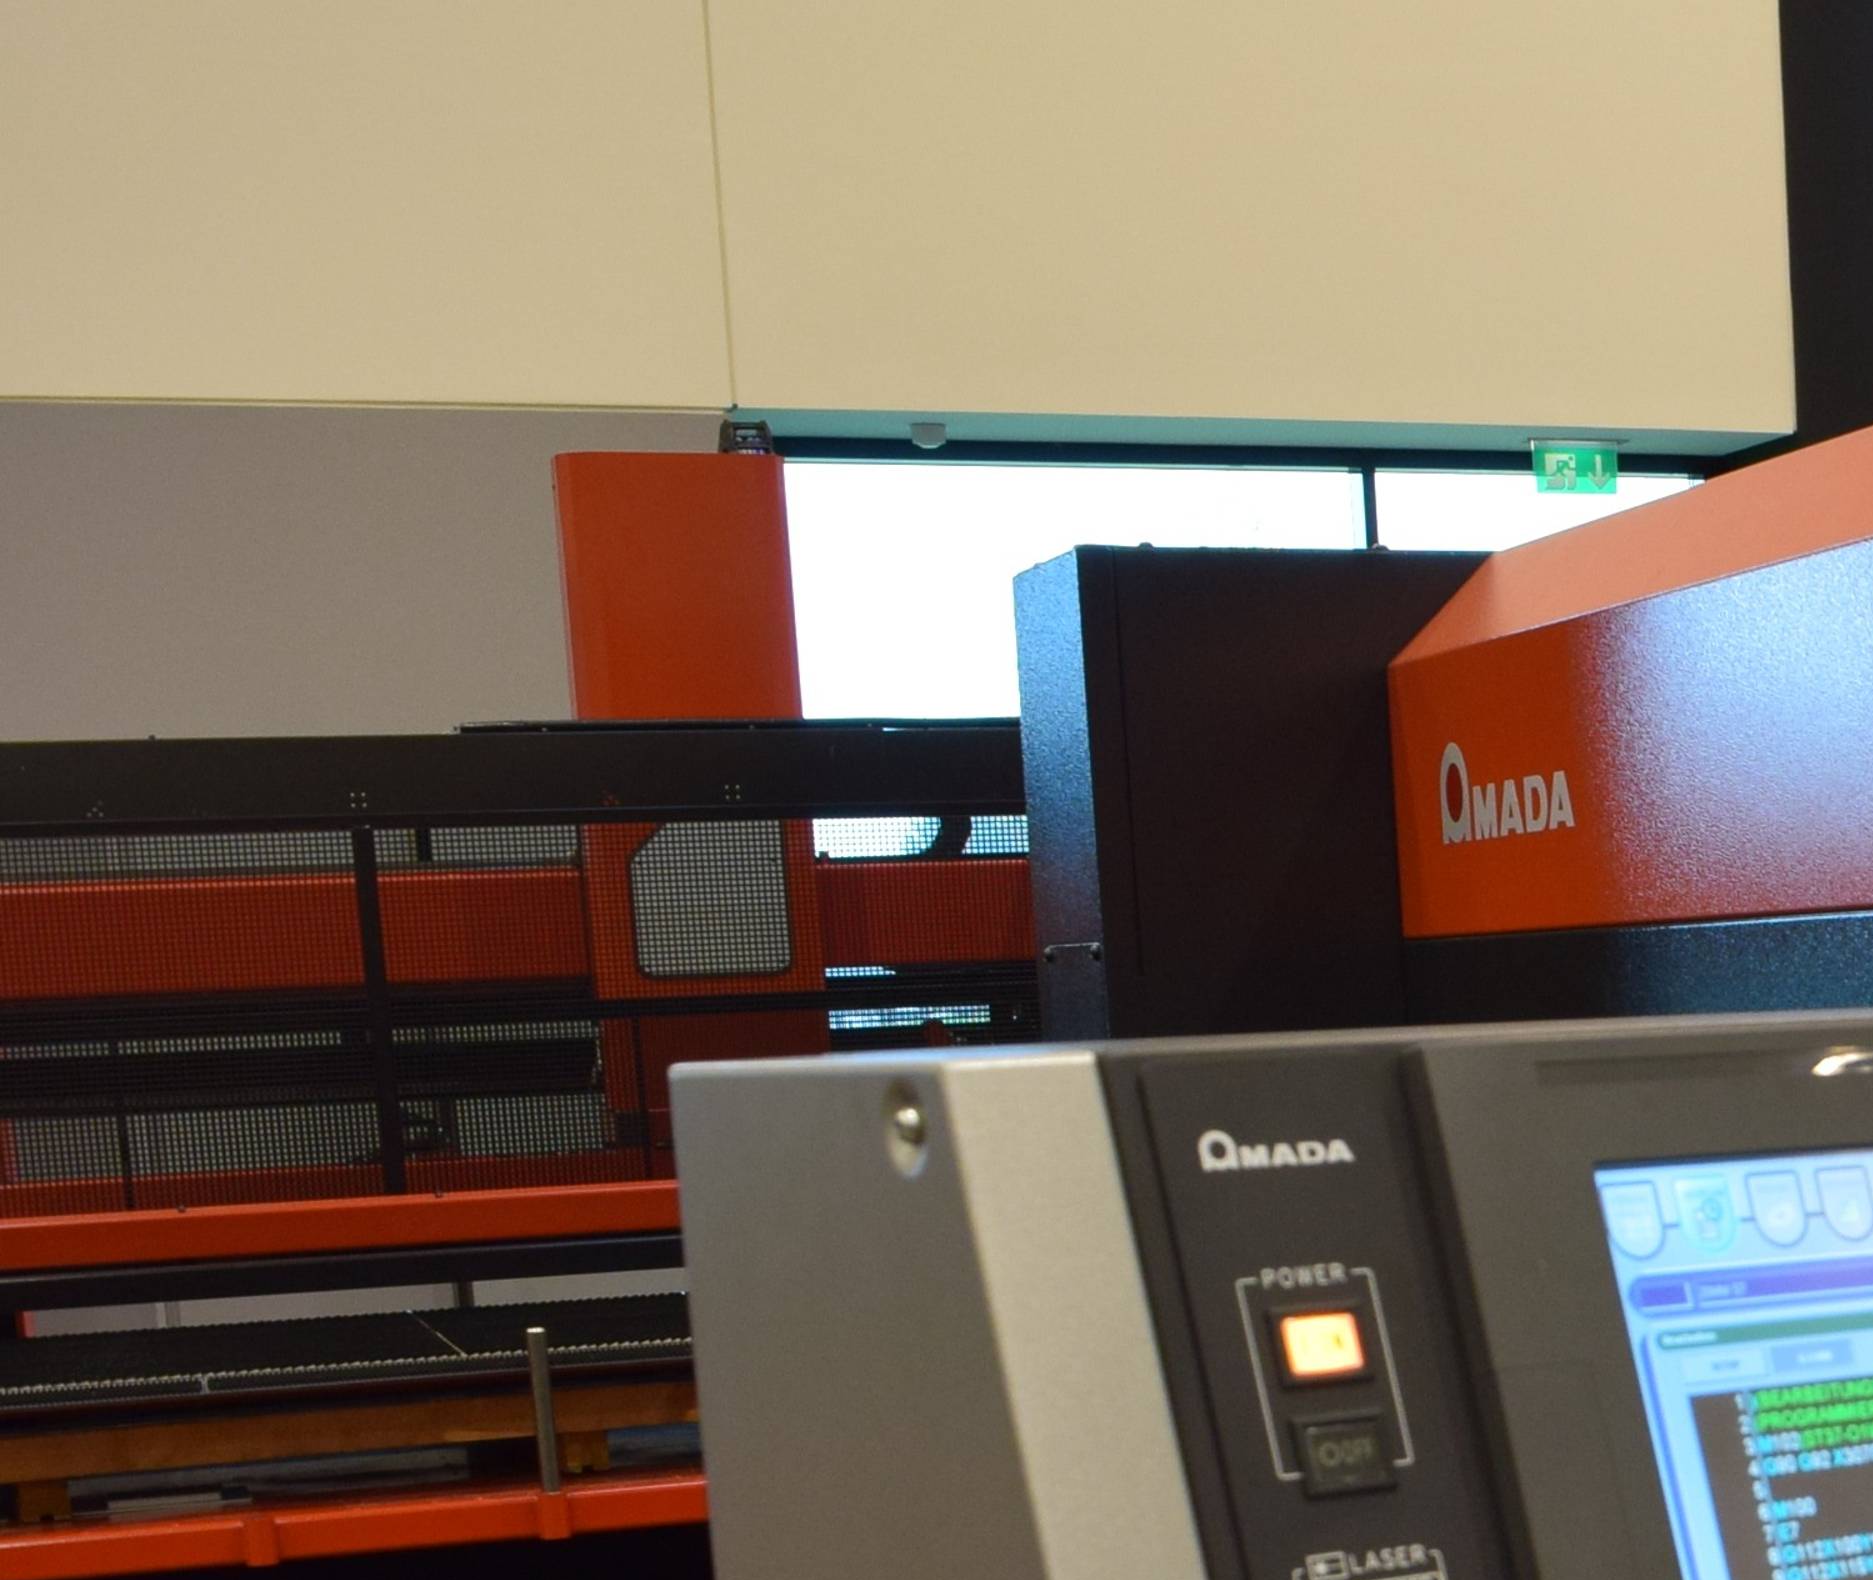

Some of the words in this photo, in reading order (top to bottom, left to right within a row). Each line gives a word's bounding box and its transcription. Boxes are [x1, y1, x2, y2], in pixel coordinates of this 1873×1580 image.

[1440, 741, 1576, 845] AMADA
[1198, 1129, 1356, 1172] AMADA
[1259, 1262, 1348, 1289] POWER
[1348, 1543, 1428, 1576] LASER
